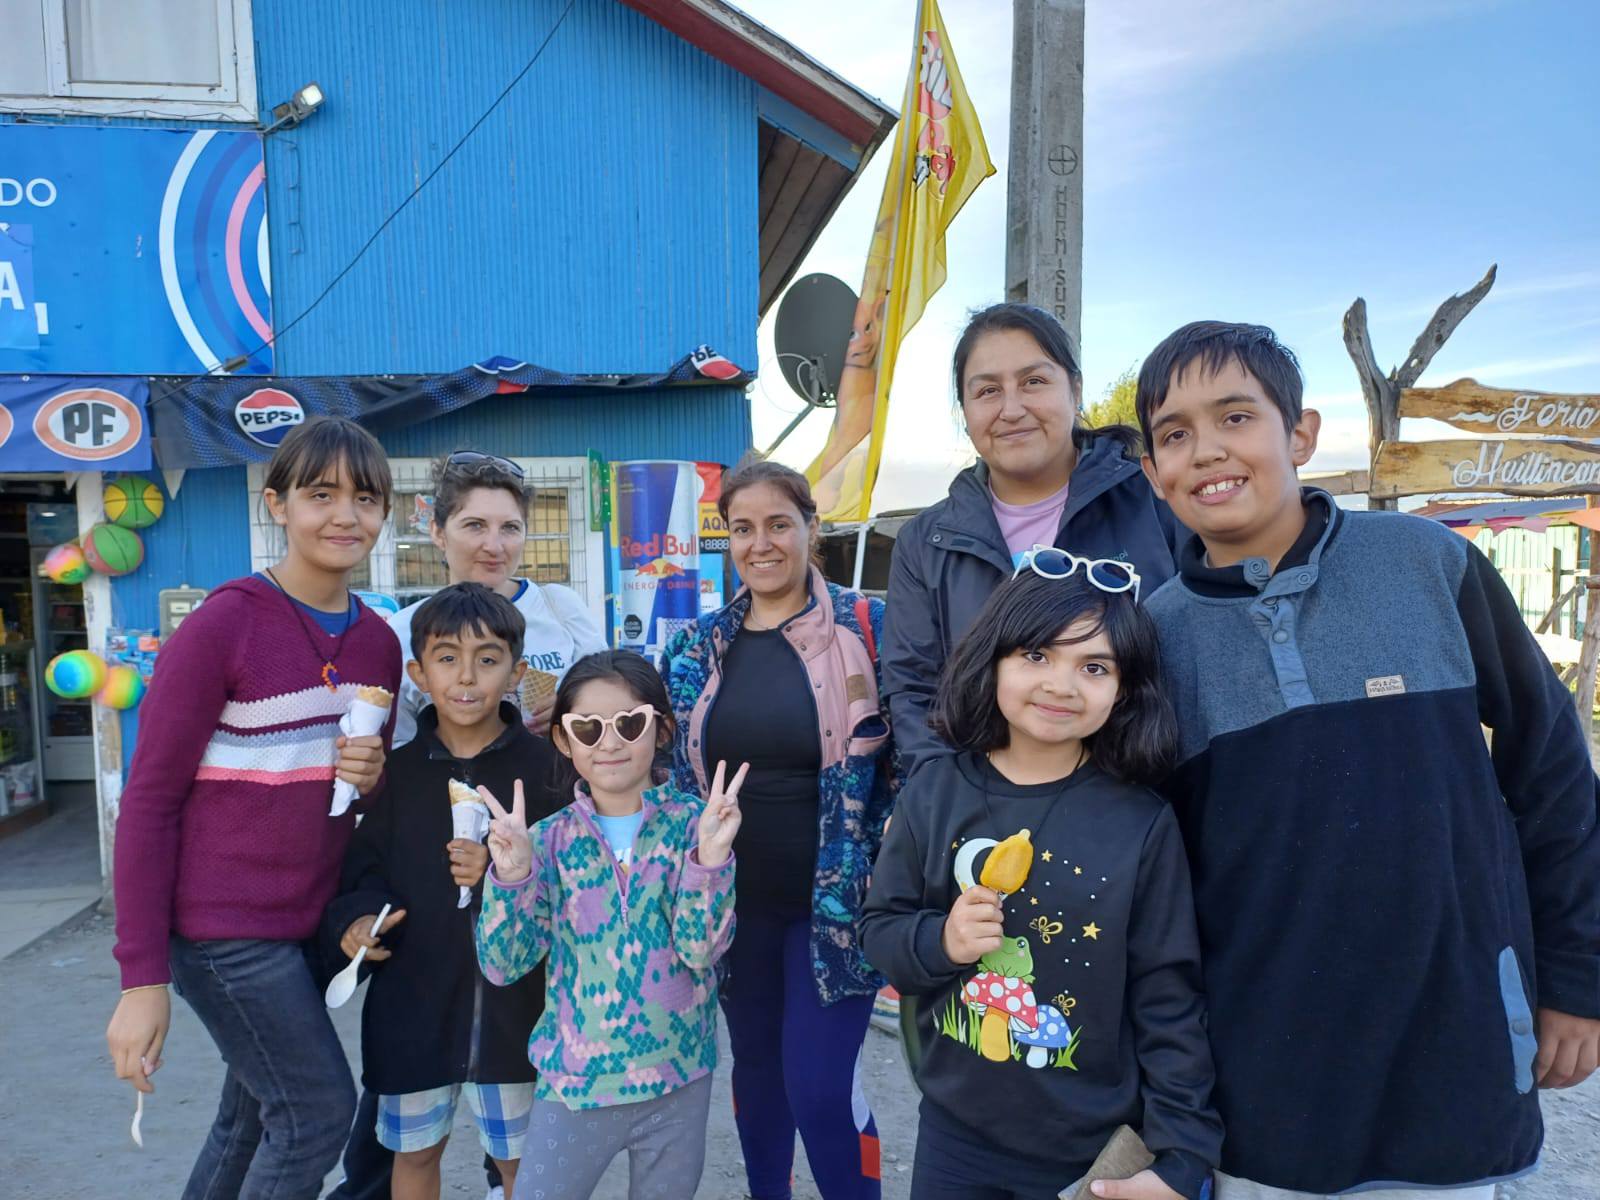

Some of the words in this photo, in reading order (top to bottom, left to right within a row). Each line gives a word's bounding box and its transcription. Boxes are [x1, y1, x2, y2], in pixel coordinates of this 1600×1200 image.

[239, 410, 300, 426] PEPSI
[621, 533, 659, 557] Red
[662, 533, 697, 556] Bull
